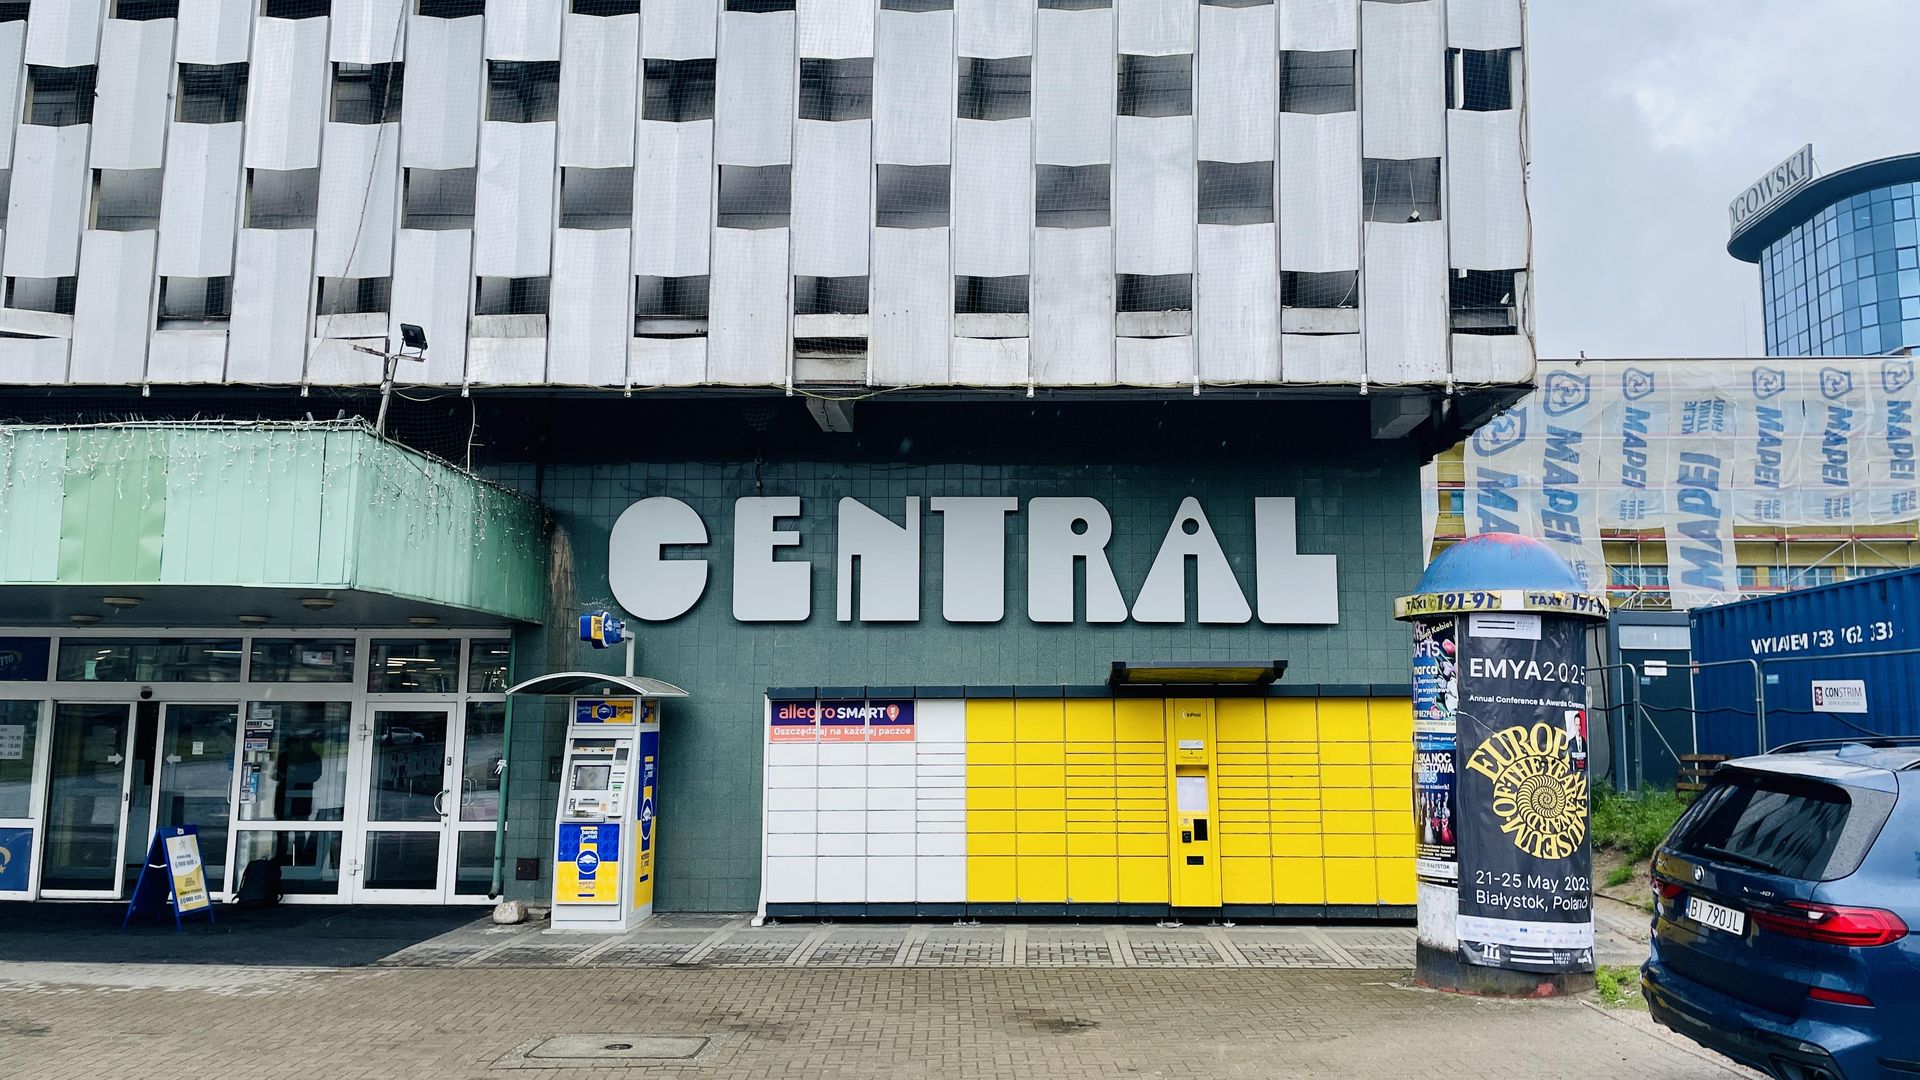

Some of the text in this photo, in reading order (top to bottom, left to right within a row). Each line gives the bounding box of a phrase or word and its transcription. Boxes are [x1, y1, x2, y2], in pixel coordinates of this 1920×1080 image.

[1682, 401, 1697, 434] KLEJE
[1697, 399, 1712, 433] TYNKI
[1711, 396, 1726, 432] FARBY
[1622, 406, 1651, 489] MAPEI
[1754, 406, 1784, 488] MAPEI
[1822, 406, 1853, 486] MAPEI
[1887, 401, 1916, 480] MAPEI
[1541, 425, 1583, 545] MAPEI
[1676, 452, 1726, 592] MAPEI
[608, 496, 1340, 625] CENTRAL
[1437, 592, 1494, 610] 191-91
[1530, 595, 1561, 606] TAX
[1469, 694, 1494, 703] Annual
[1495, 696, 1538, 705] Conference
[1825, 687, 1862, 698] CONSTRIM
[779, 703, 836, 723] allegro
[844, 727, 877, 738] każdej
[878, 728, 911, 736] paczce
[1431, 752, 1451, 763] NOC
[1504, 755, 1543, 789] THE
[1492, 781, 1518, 818] OF
[1475, 870, 1522, 888] 21-25
[1527, 874, 1559, 893] May
[1476, 889, 1588, 913] Białystok, Poland
[1706, 905, 1739, 932] 790JL
